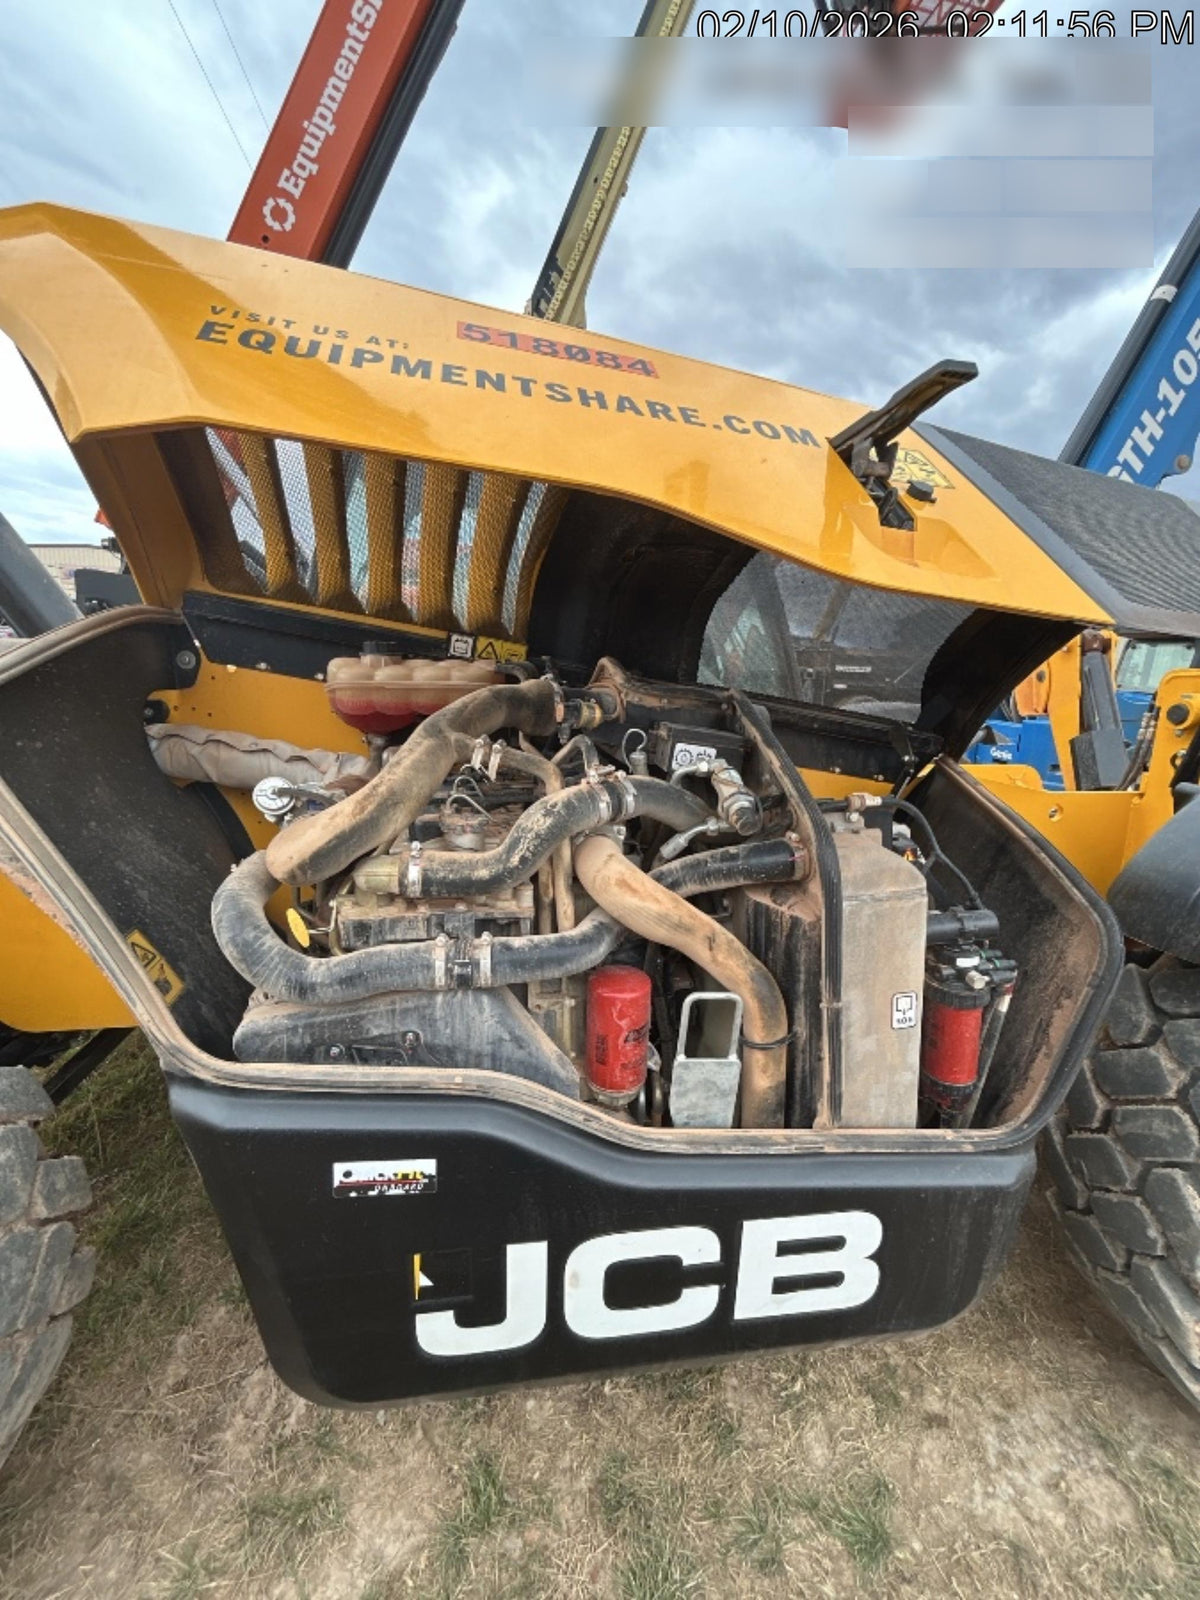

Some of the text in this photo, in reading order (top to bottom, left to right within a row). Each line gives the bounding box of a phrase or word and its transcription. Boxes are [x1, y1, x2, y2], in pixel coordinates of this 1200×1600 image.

[277, 0, 383, 200] EquipmentS
[195, 319, 822, 449] EQUIPMENTSHARE.COM
[210, 304, 410, 350] VISIT US AT:
[461, 322, 656, 377] 518084
[415, 1209, 883, 1357] JCB
